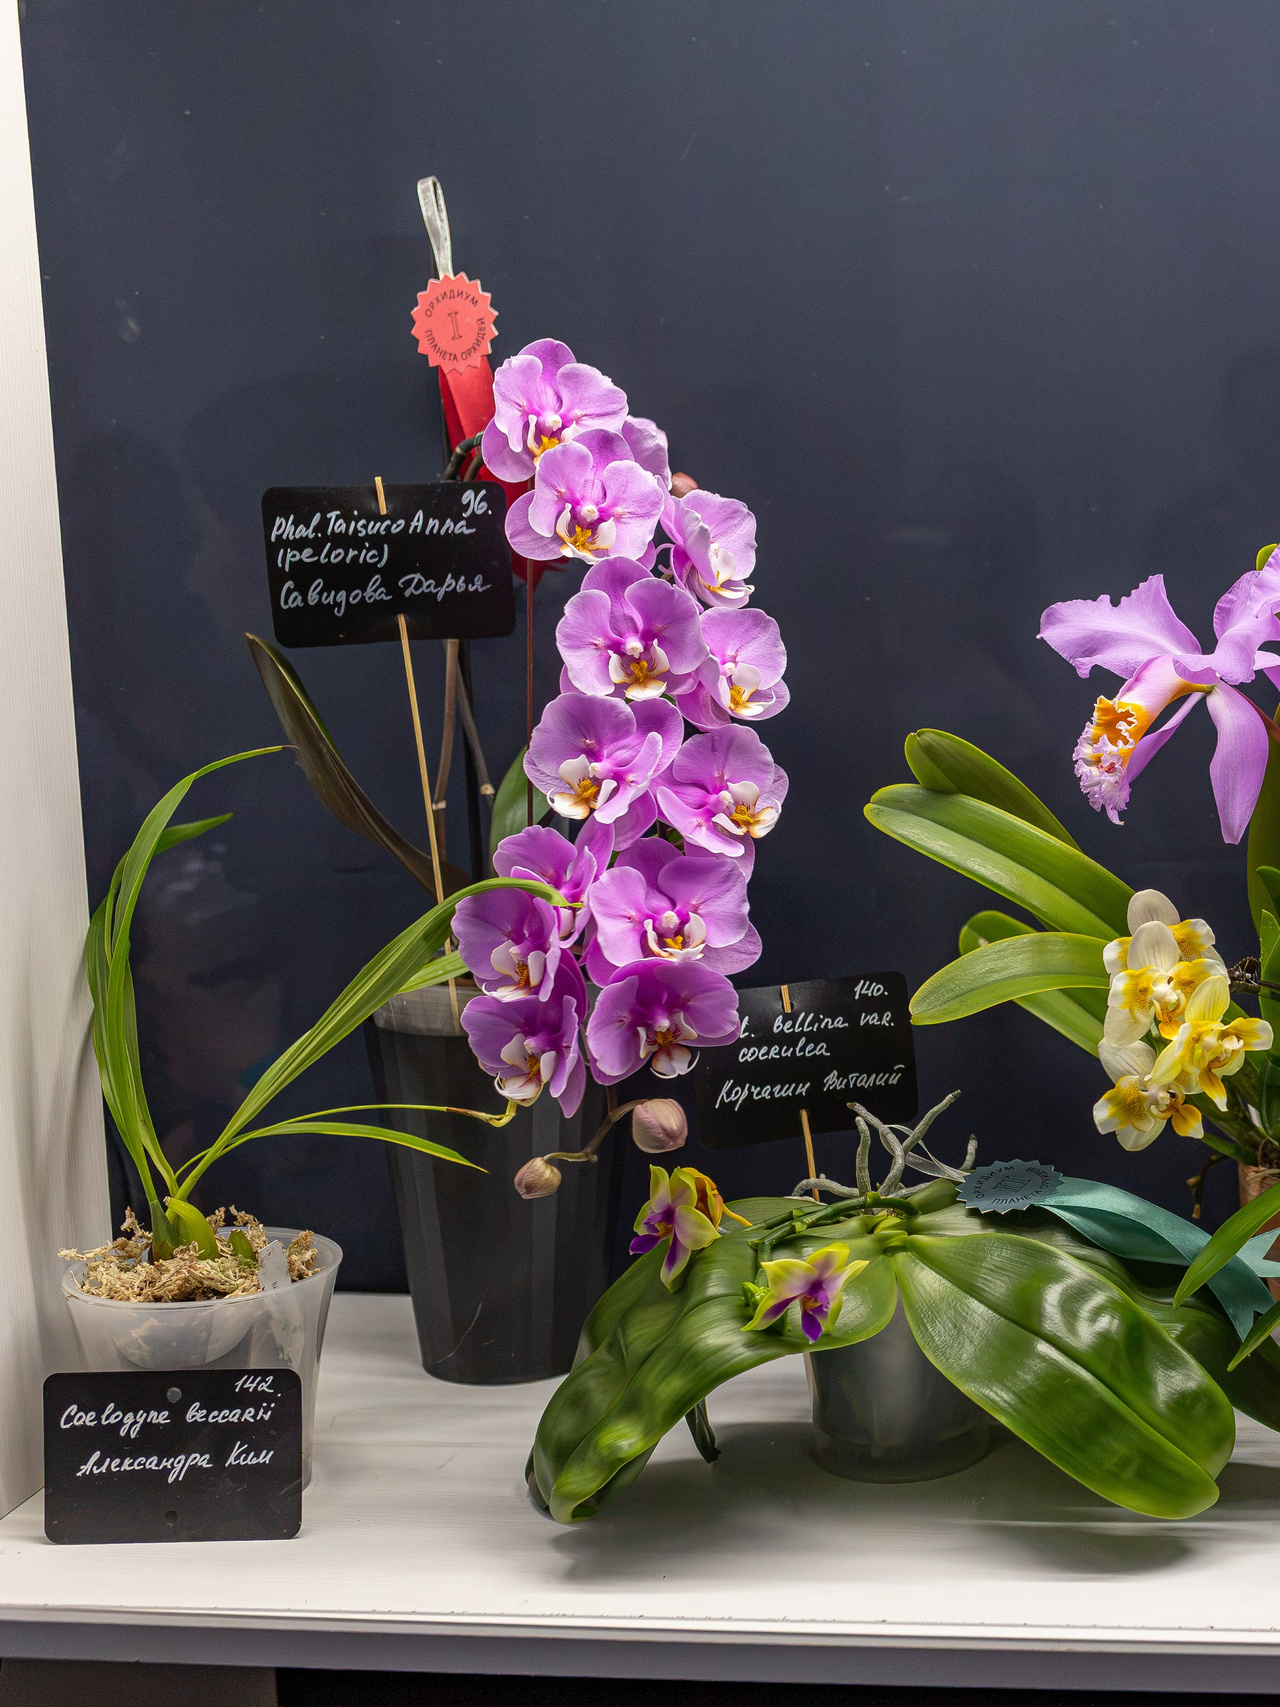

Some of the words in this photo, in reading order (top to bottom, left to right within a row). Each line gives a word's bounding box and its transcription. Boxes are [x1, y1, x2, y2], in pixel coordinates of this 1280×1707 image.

[425, 289, 478, 318] ОРХИДИУМ
[424, 329, 458, 362] ПЛАНЕТА
[461, 317, 486, 361] ОРХИДЕЙ
[326, 510, 406, 537] Taisuco
[408, 510, 477, 535] Anna
[277, 542, 389, 572] (peloric)
[398, 572, 492, 602] Дарья
[715, 1079, 811, 1112] Корчагин
[823, 1064, 906, 1091] Виталий
[973, 1165, 1014, 1199] ОРХИДИУМ
[991, 1190, 1041, 1205] ПЛАНЕТА
[60, 1403, 171, 1438] Coelogyne
[76, 1451, 213, 1484] Александра
[225, 1441, 274, 1467] Ким
